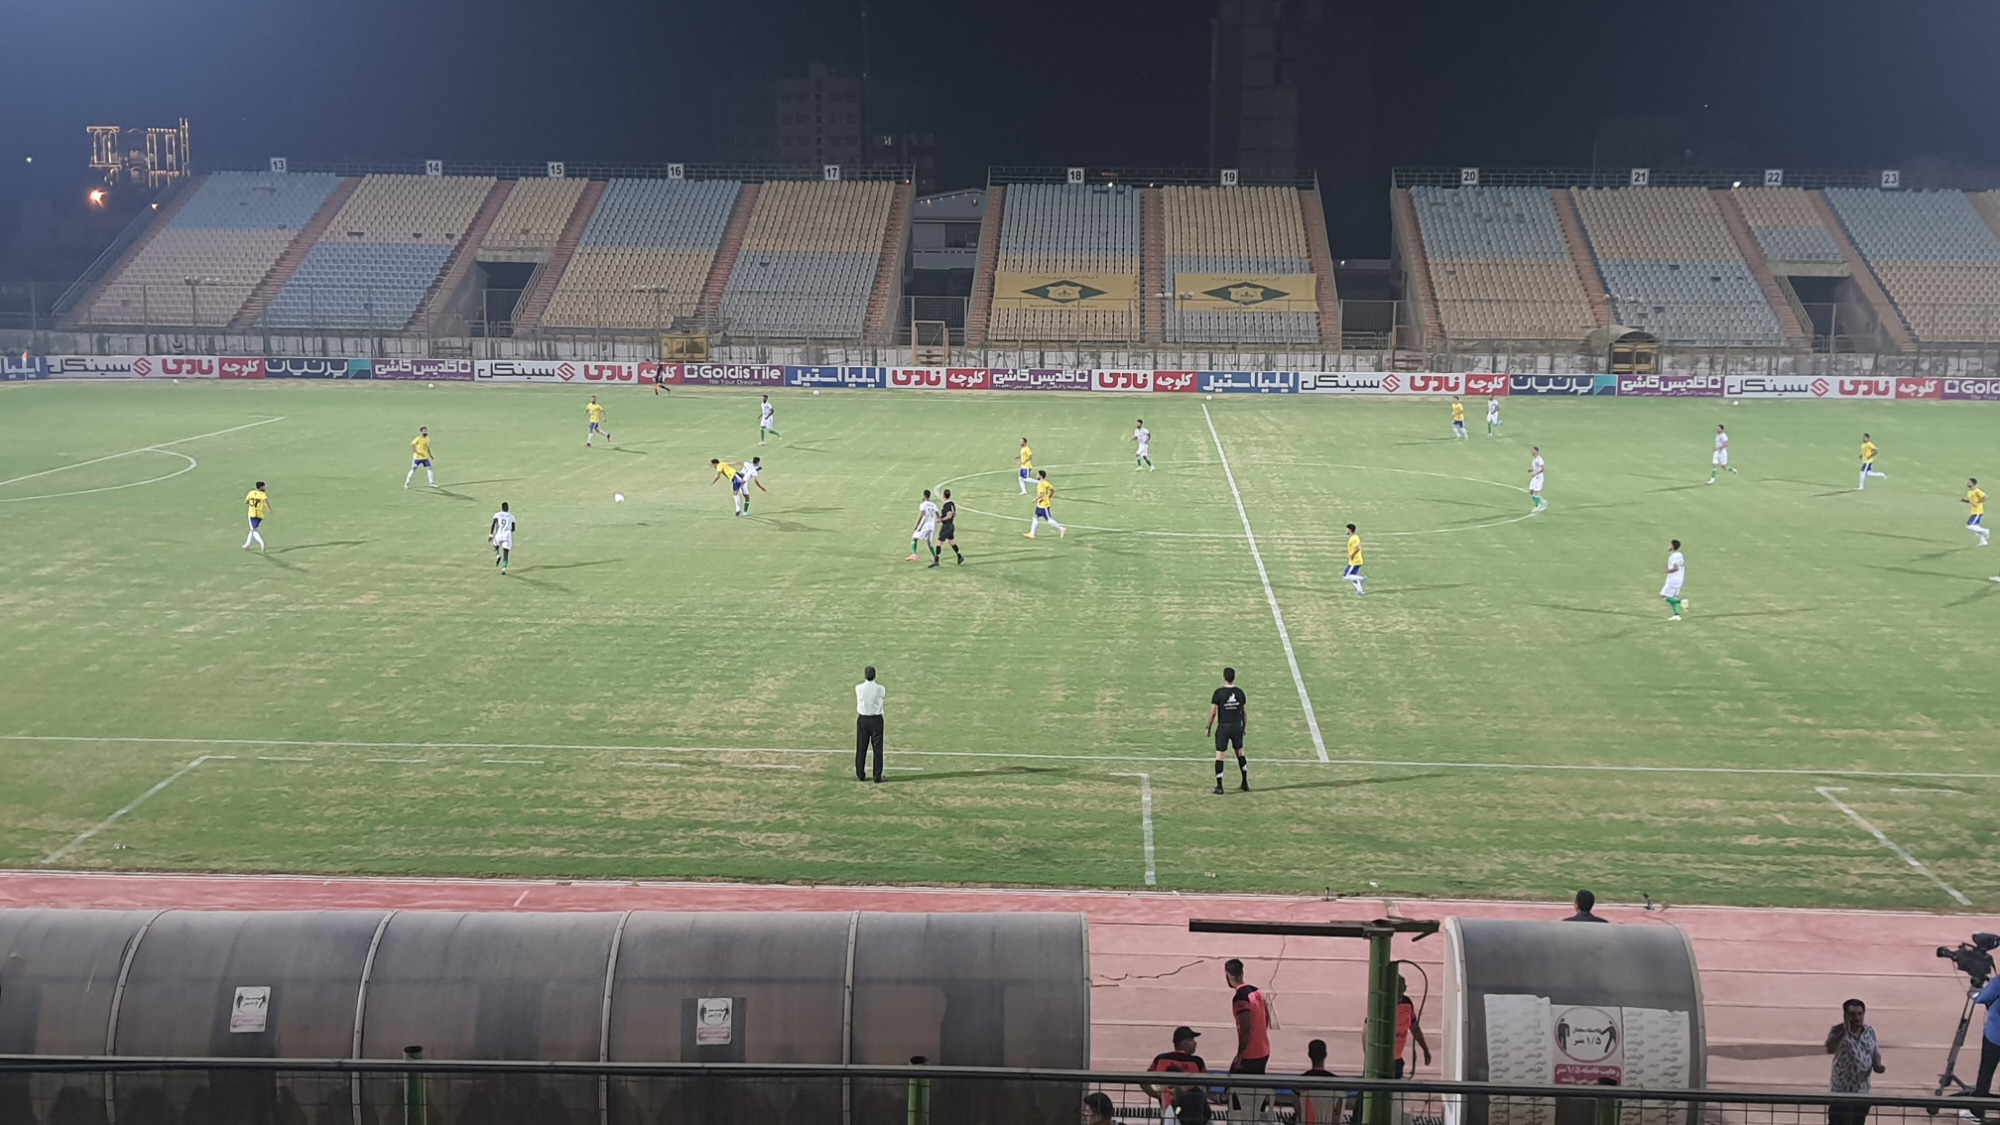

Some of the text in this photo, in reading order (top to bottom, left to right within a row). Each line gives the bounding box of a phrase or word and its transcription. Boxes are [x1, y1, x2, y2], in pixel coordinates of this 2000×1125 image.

[273, 159, 285, 171] 13
[428, 162, 440, 173] 14
[550, 164, 563, 175] 15
[669, 166, 682, 177] 16
[826, 167, 838, 178] 17
[1070, 170, 1082, 181] 18
[1223, 171, 1236, 182] 19
[1463, 171, 1476, 182] 20
[1633, 172, 1646, 183] 21
[1767, 172, 1780, 183] 22
[1884, 173, 1897, 184] 23
[222, 359, 260, 376] کلوچه
[265, 359, 348, 379] پرنیان
[375, 359, 412, 375] کاشی
[790, 367, 880, 388] ایلیا استیل
[949, 370, 986, 387] کلوچه
[993, 369, 1030, 385] کاشی
[1156, 373, 1194, 391] کلوچه
[1202, 372, 1294, 393] ایلیا استیل
[1621, 376, 1659, 391] کاشی
[1468, 375, 1506, 393] کلوچه
[1510, 376, 1594, 395] پرنیان
[1899, 380, 1938, 397] کلوچه
[501, 519, 507, 529] 9
